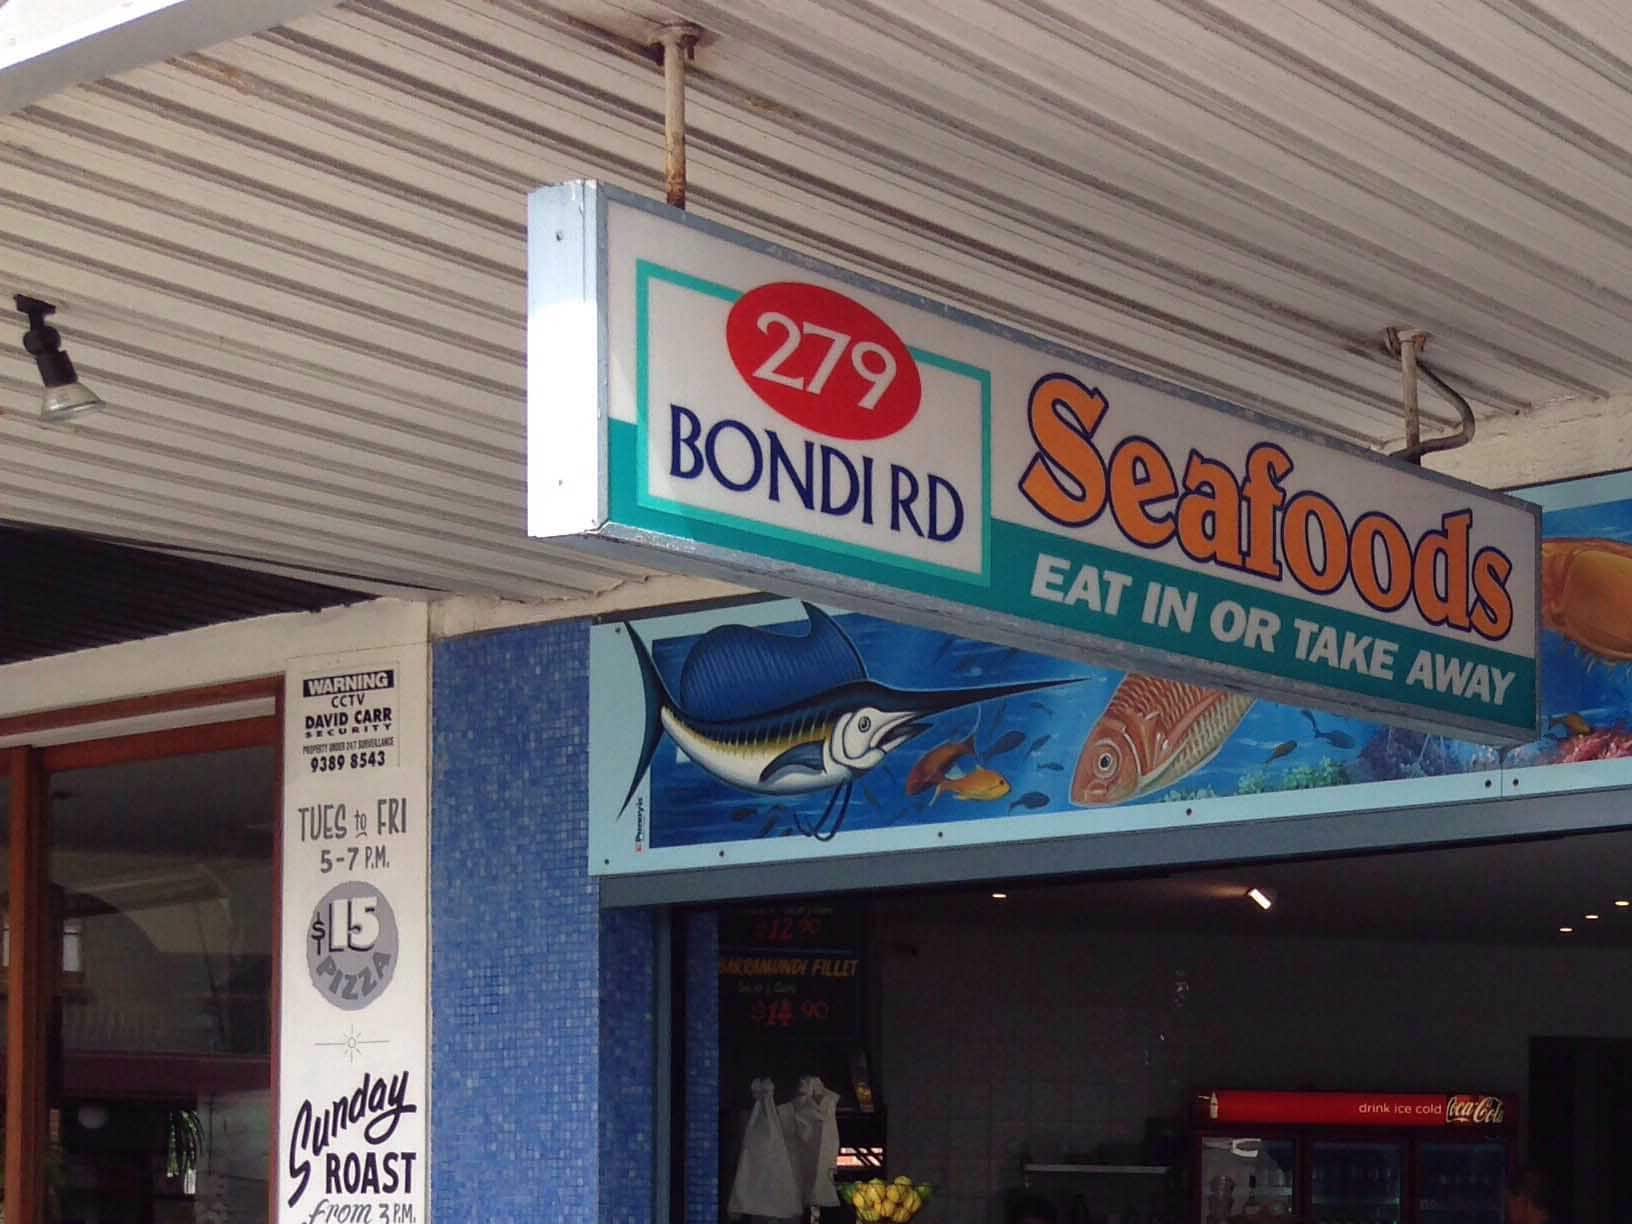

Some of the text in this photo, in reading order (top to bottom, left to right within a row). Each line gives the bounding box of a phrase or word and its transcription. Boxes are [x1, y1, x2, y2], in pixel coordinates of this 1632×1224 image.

[752, 311, 897, 411] 279
[669, 403, 965, 544] BONDI RD
[1017, 371, 1514, 641] Seafoods
[1029, 553, 1517, 710] EAT IN OR TAKE AWAY
[308, 672, 388, 696] WARNING
[331, 693, 365, 708] CCTV
[305, 707, 392, 729] DAVID CARR
[305, 723, 392, 738] SECURITY
[311, 750, 385, 773] 9389 8543
[298, 803, 347, 843] TUES
[376, 797, 408, 836] FRI
[365, 845, 390, 870] P.M.
[316, 950, 391, 1001] PIZZA
[1359, 1103, 1442, 1115] drink ice cold
[288, 1070, 417, 1208] Sunday
[325, 1151, 417, 1195] ROAST
[393, 1203, 416, 1224] P.M.
